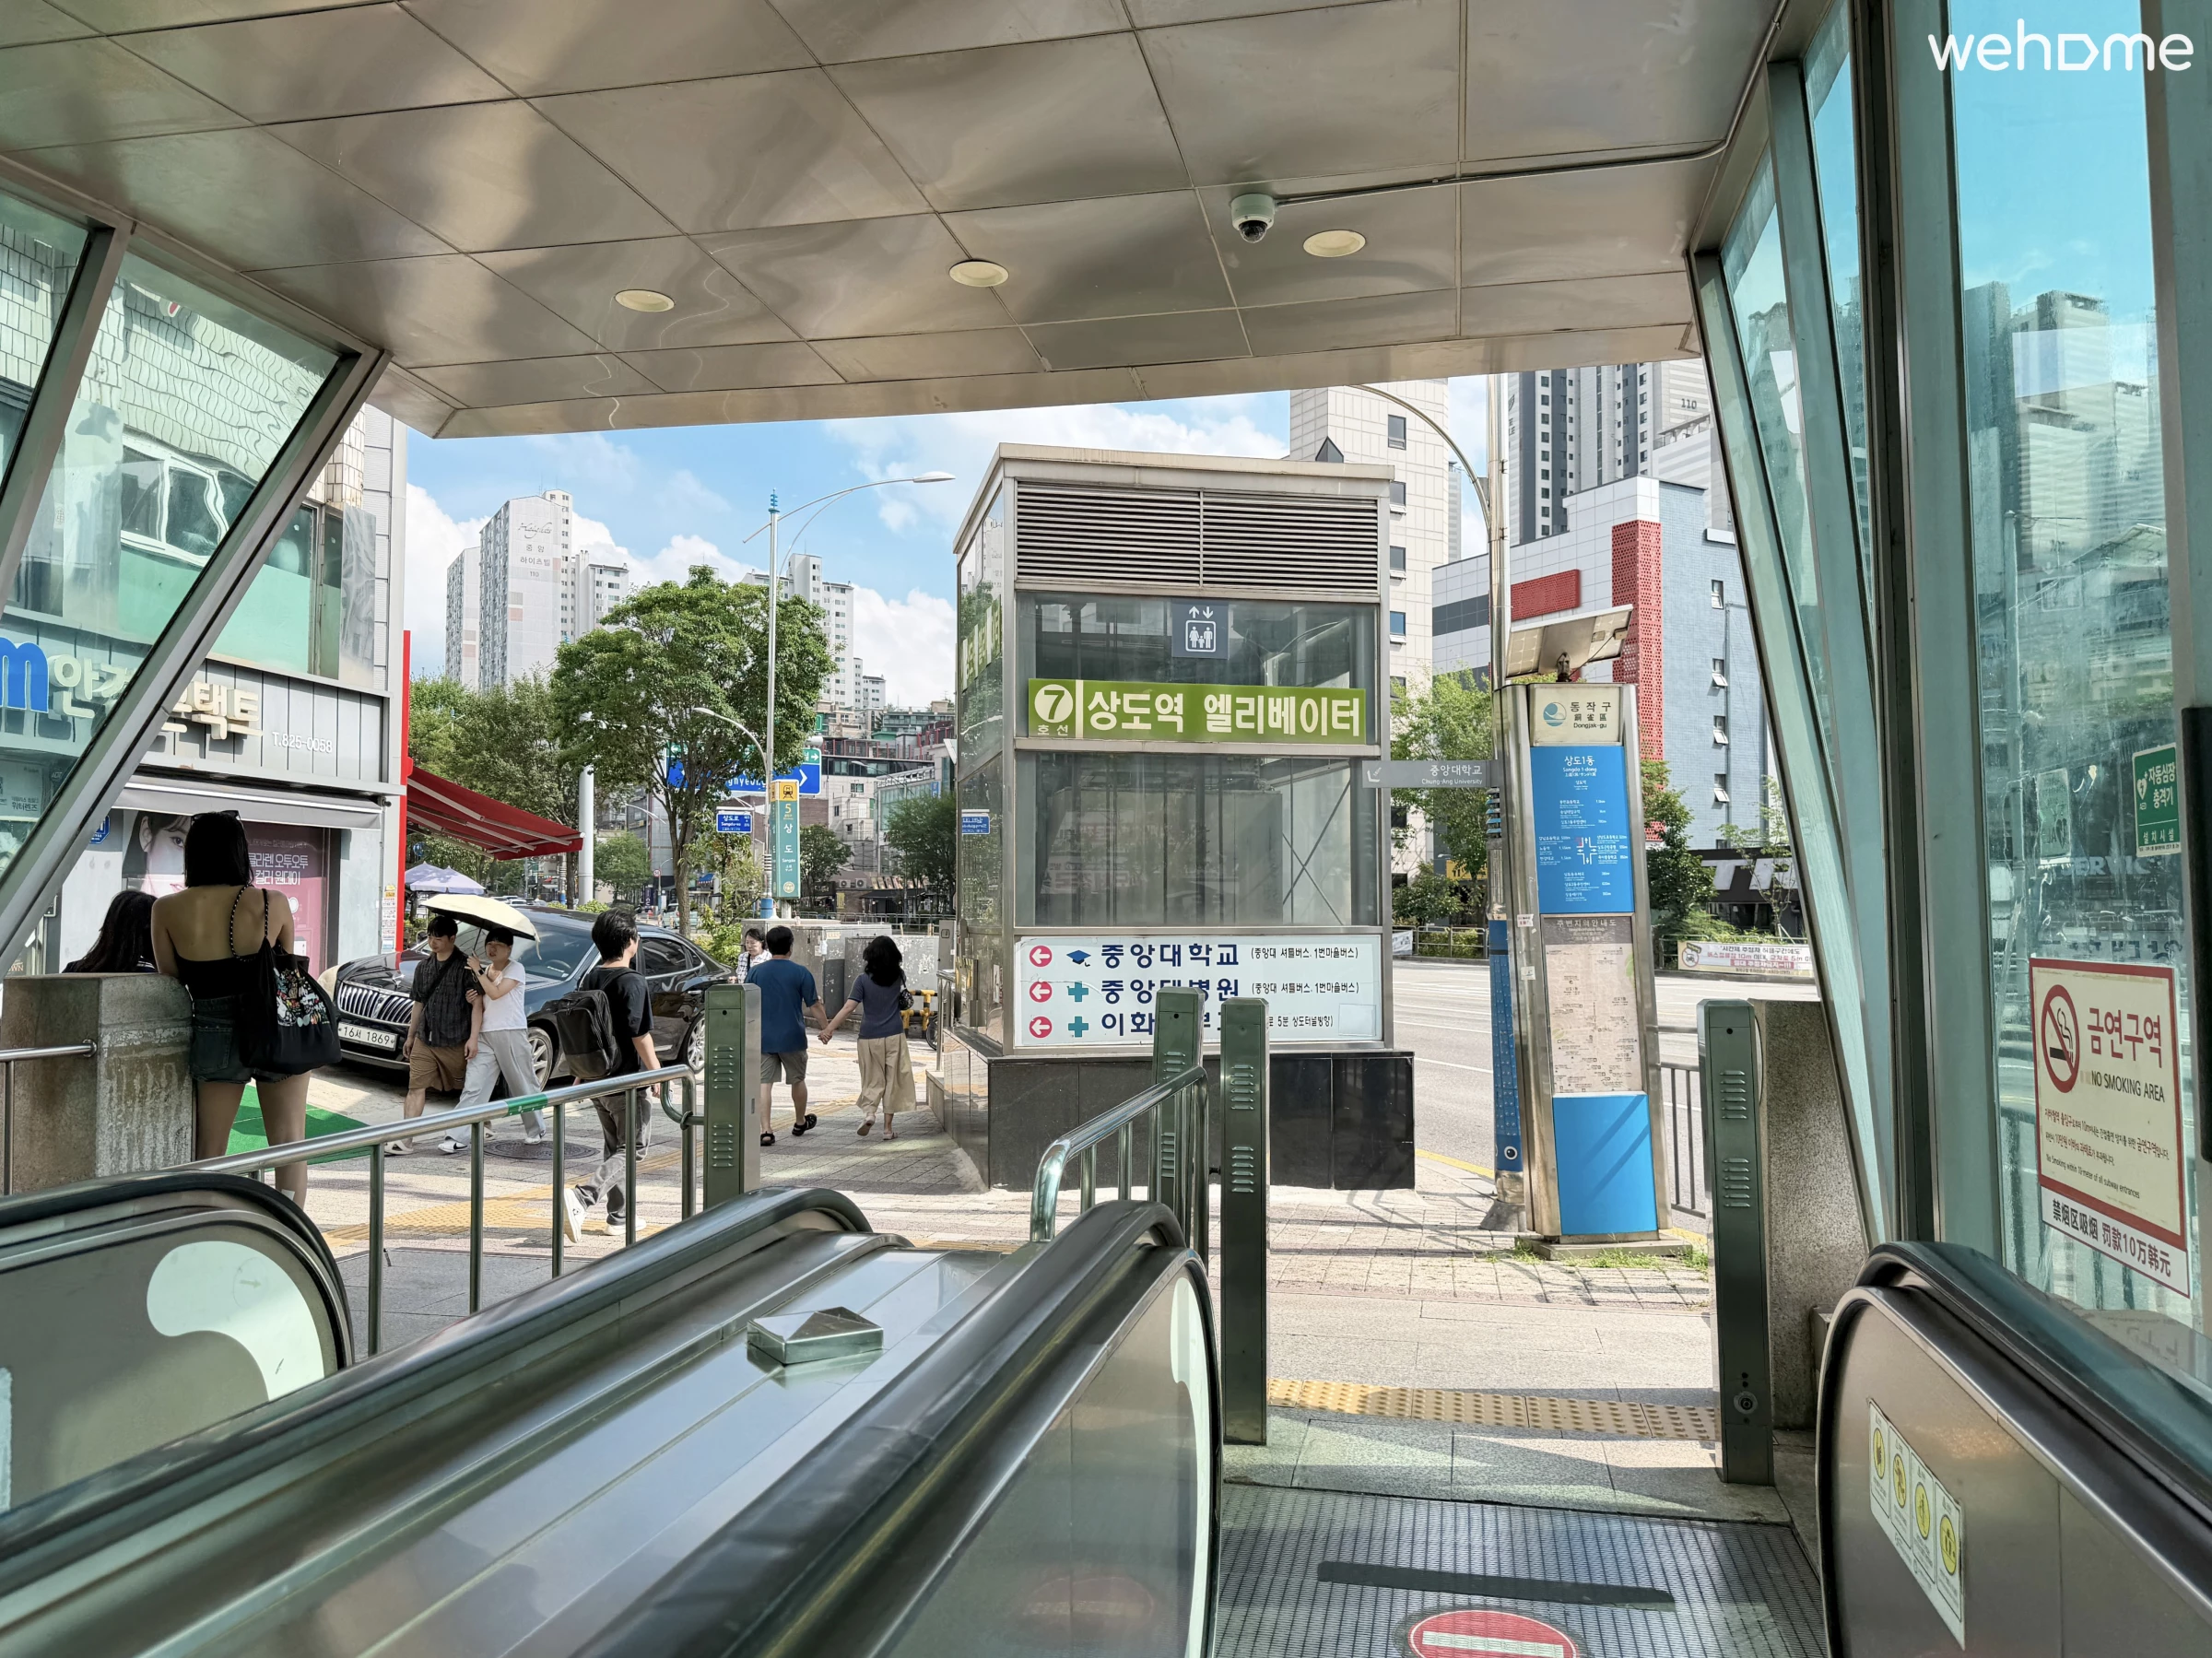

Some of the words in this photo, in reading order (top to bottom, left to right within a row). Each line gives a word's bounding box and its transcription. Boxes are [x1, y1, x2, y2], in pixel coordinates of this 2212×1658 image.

[1681, 398, 1697, 409] 110
[520, 557, 550, 566] 하이츠빌
[1043, 689, 1065, 720] 7
[1570, 701, 1611, 712] 동작구
[1088, 691, 1183, 733] 상도역
[1204, 694, 1359, 736] 엘리베이터
[1037, 724, 1069, 736] 호선
[272, 731, 333, 753] T.825-0058
[1564, 756, 1594, 766] 상도1동
[1430, 765, 1483, 776] 중앙대학교
[2148, 761, 2176, 785] 자동심장
[2152, 786, 2173, 808] 충격기
[784, 804, 792, 814] 5
[783, 823, 794, 853] 상도
[2143, 828, 2174, 845] 설치시설
[275, 853, 309, 869] 오투오투
[275, 870, 300, 886] 원데이
[1101, 943, 1239, 969] 중앙대학교
[1251, 947, 1277, 959] (중앙대
[1314, 947, 1359, 959] 1번마을버스)
[1252, 982, 1277, 994] (중앙대
[1315, 982, 1359, 994] 1번마을버스)
[1277, 1016, 1288, 1027] 5분
[1292, 1016, 1334, 1027] 상도터널방향)
[344, 1026, 361, 1039] 16서
[367, 1031, 390, 1045] 1869
[2088, 1007, 2162, 1068] 금연구역
[2091, 1070, 2102, 1087] NO
[2104, 1074, 2141, 1097] SMOKING
[2143, 1083, 2165, 1102] AREA
[2052, 1156, 2066, 1170] Smoking
[2094, 1173, 2099, 1182] of
[2104, 1178, 2119, 1192] subway
[2120, 1183, 2140, 1198] entrances
[2053, 1199, 2099, 1241] 禁烟区吸烟
[2101, 1222, 2171, 1277] 罚款10万韩元
